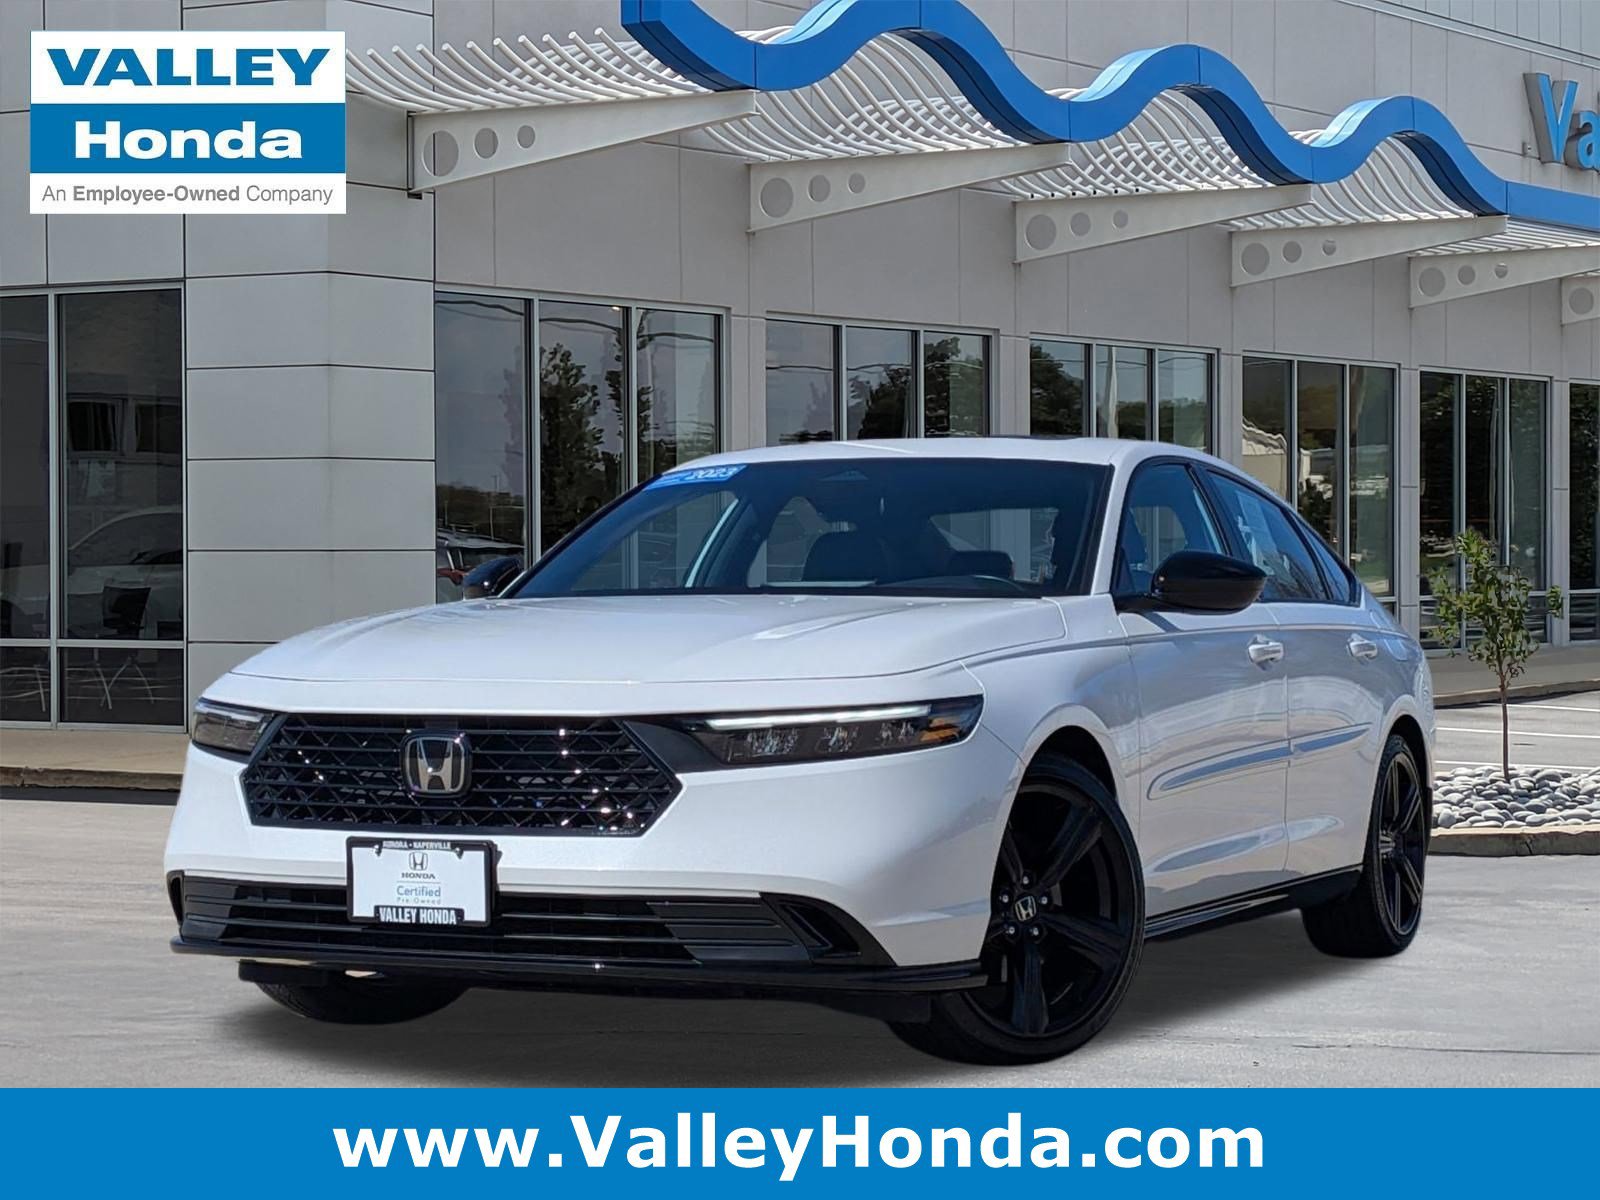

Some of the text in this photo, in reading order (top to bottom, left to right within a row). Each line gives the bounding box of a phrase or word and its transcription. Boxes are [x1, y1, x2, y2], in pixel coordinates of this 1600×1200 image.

[413, 841, 452, 850] NAPERVILLE
[401, 872, 436, 880] HONDA
[396, 885, 441, 897] Certified
[379, 907, 457, 925] VALLEY HONDA
